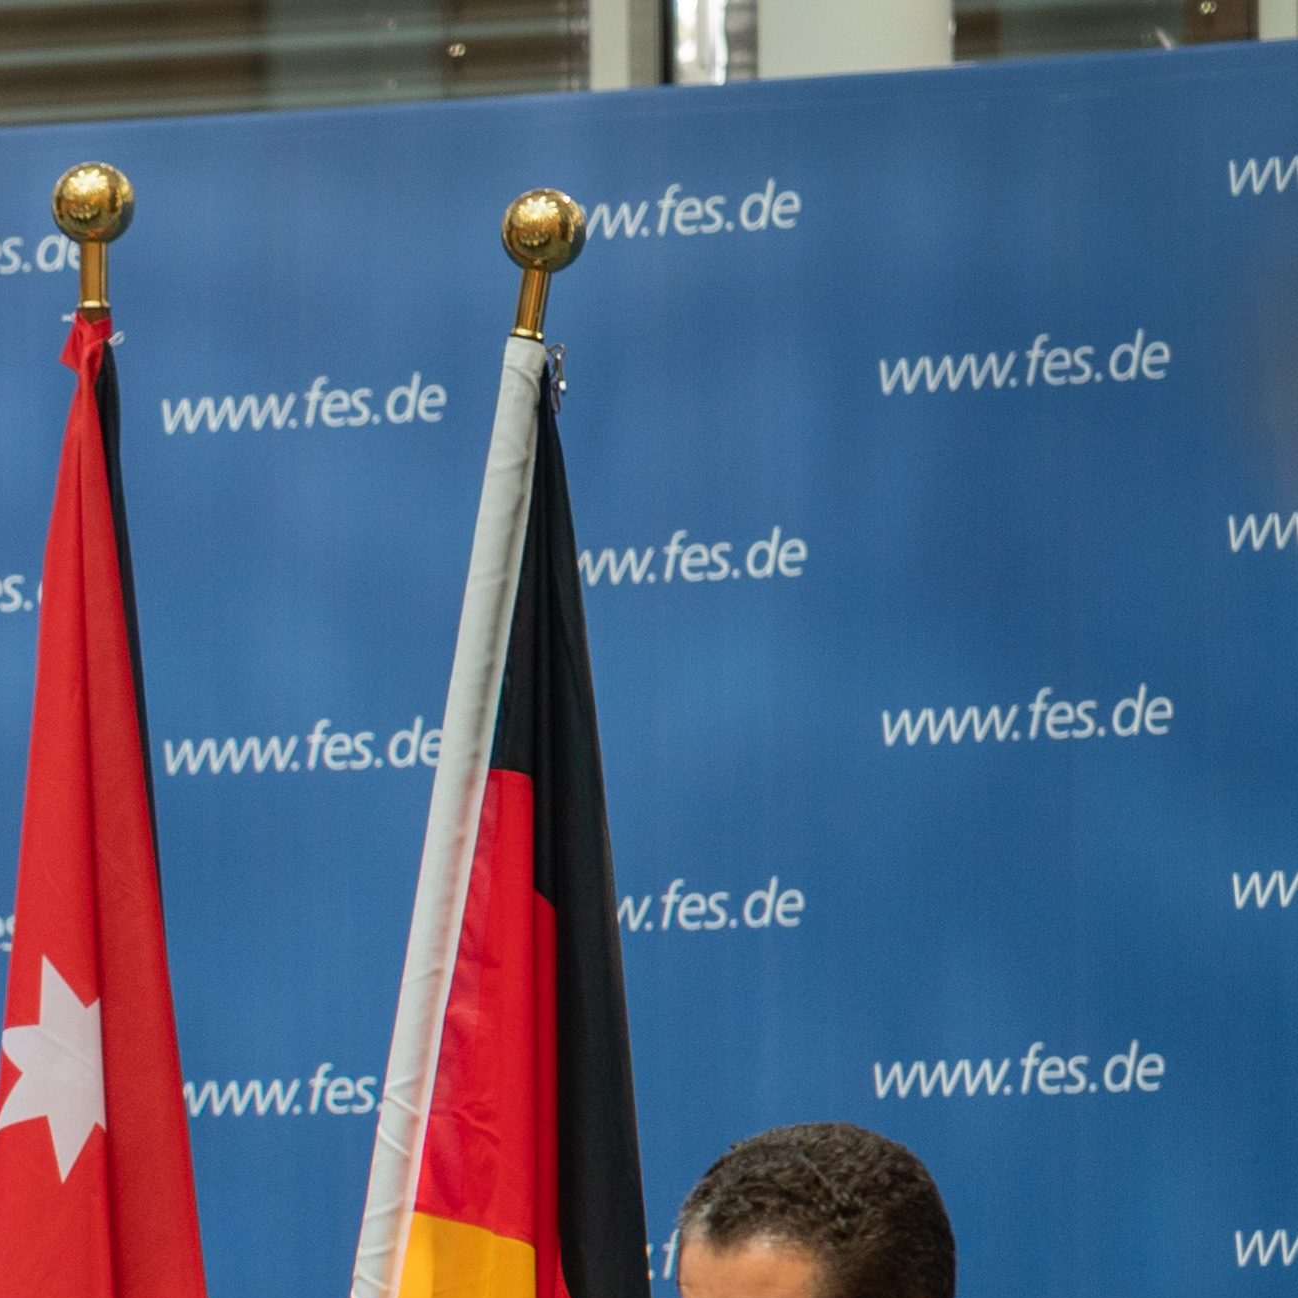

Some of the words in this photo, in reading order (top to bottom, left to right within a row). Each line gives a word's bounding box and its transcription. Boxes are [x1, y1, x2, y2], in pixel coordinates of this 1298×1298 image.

[879, 328, 1171, 395] www.fes.de
[161, 372, 447, 435] www.fes.de
[881, 683, 1174, 747] www.fes.de
[873, 1039, 1165, 1099] www.fes.de
